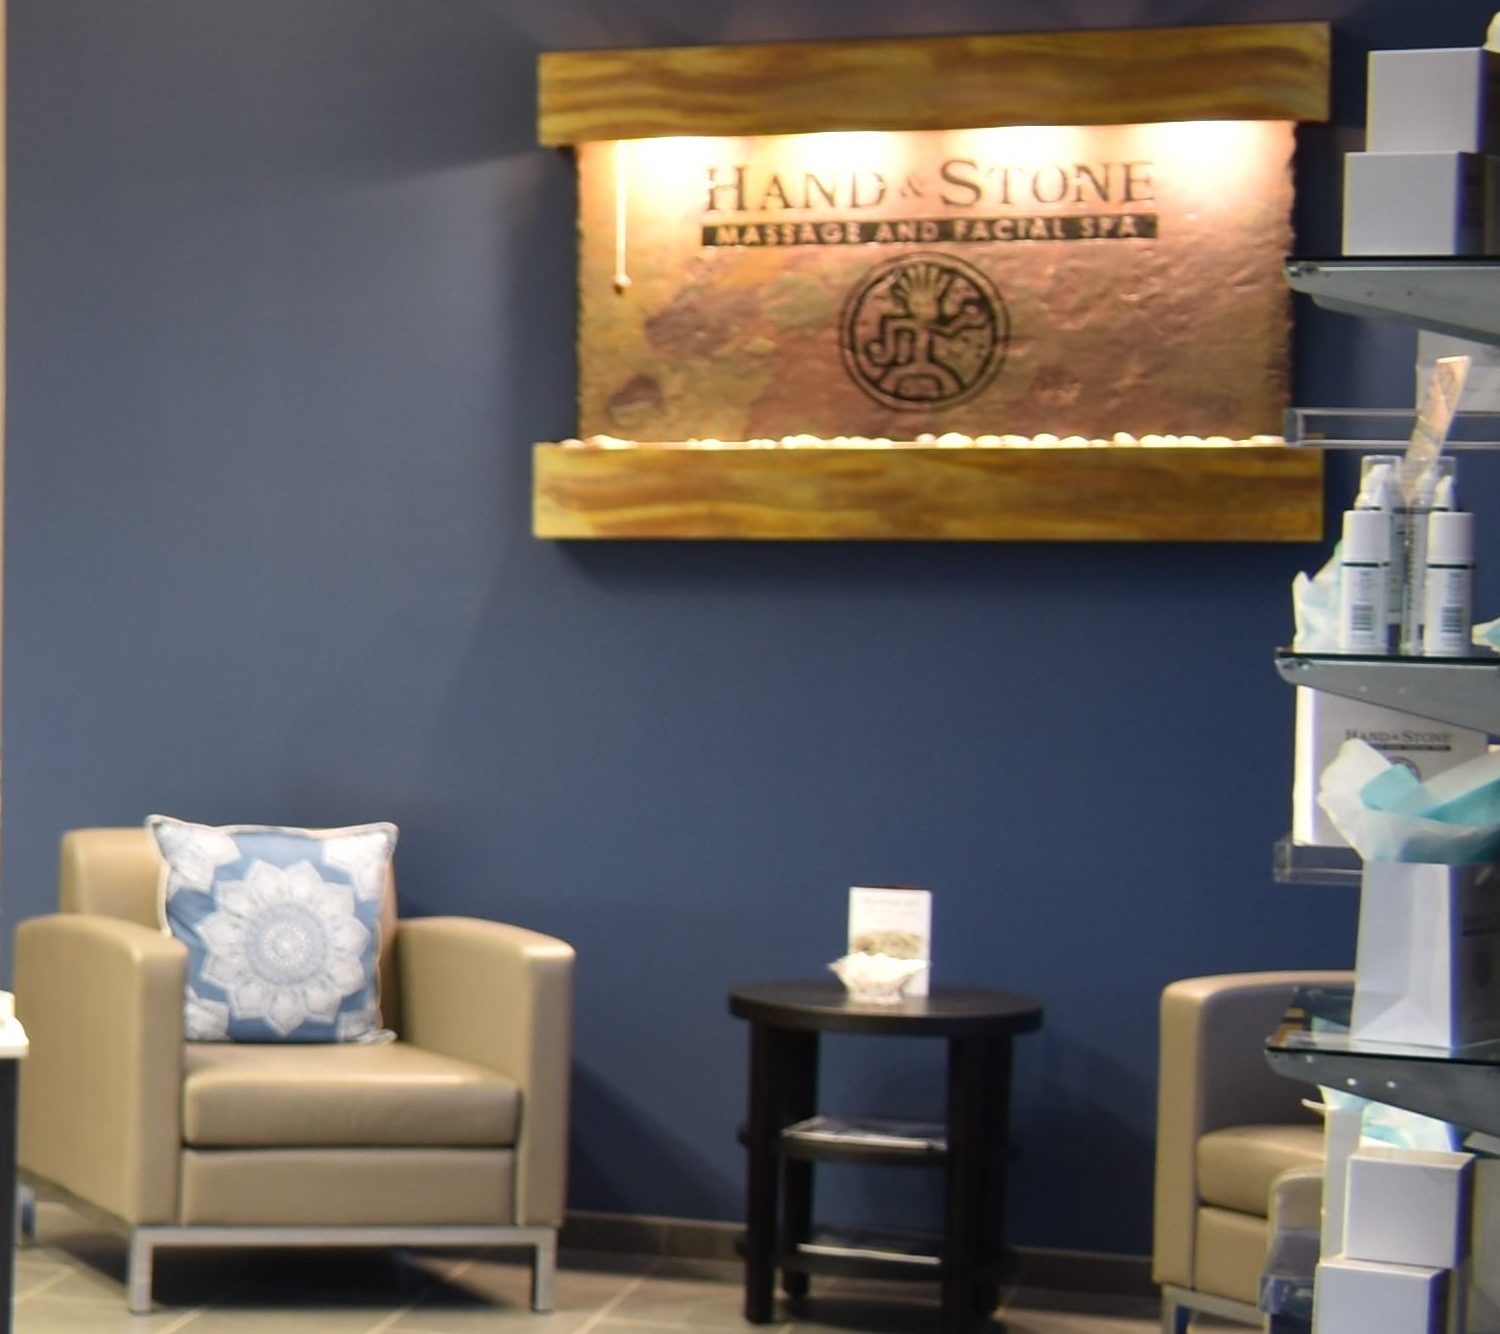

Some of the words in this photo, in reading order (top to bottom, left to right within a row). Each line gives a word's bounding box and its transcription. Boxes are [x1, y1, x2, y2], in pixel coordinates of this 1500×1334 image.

[704, 164, 885, 211] HAND
[900, 178, 923, 198] &
[941, 158, 1155, 208] STONE
[715, 222, 861, 245] MASSAGE
[874, 220, 936, 242] AND
[955, 217, 1063, 240] FACIAL
[1081, 215, 1137, 238] SPA
